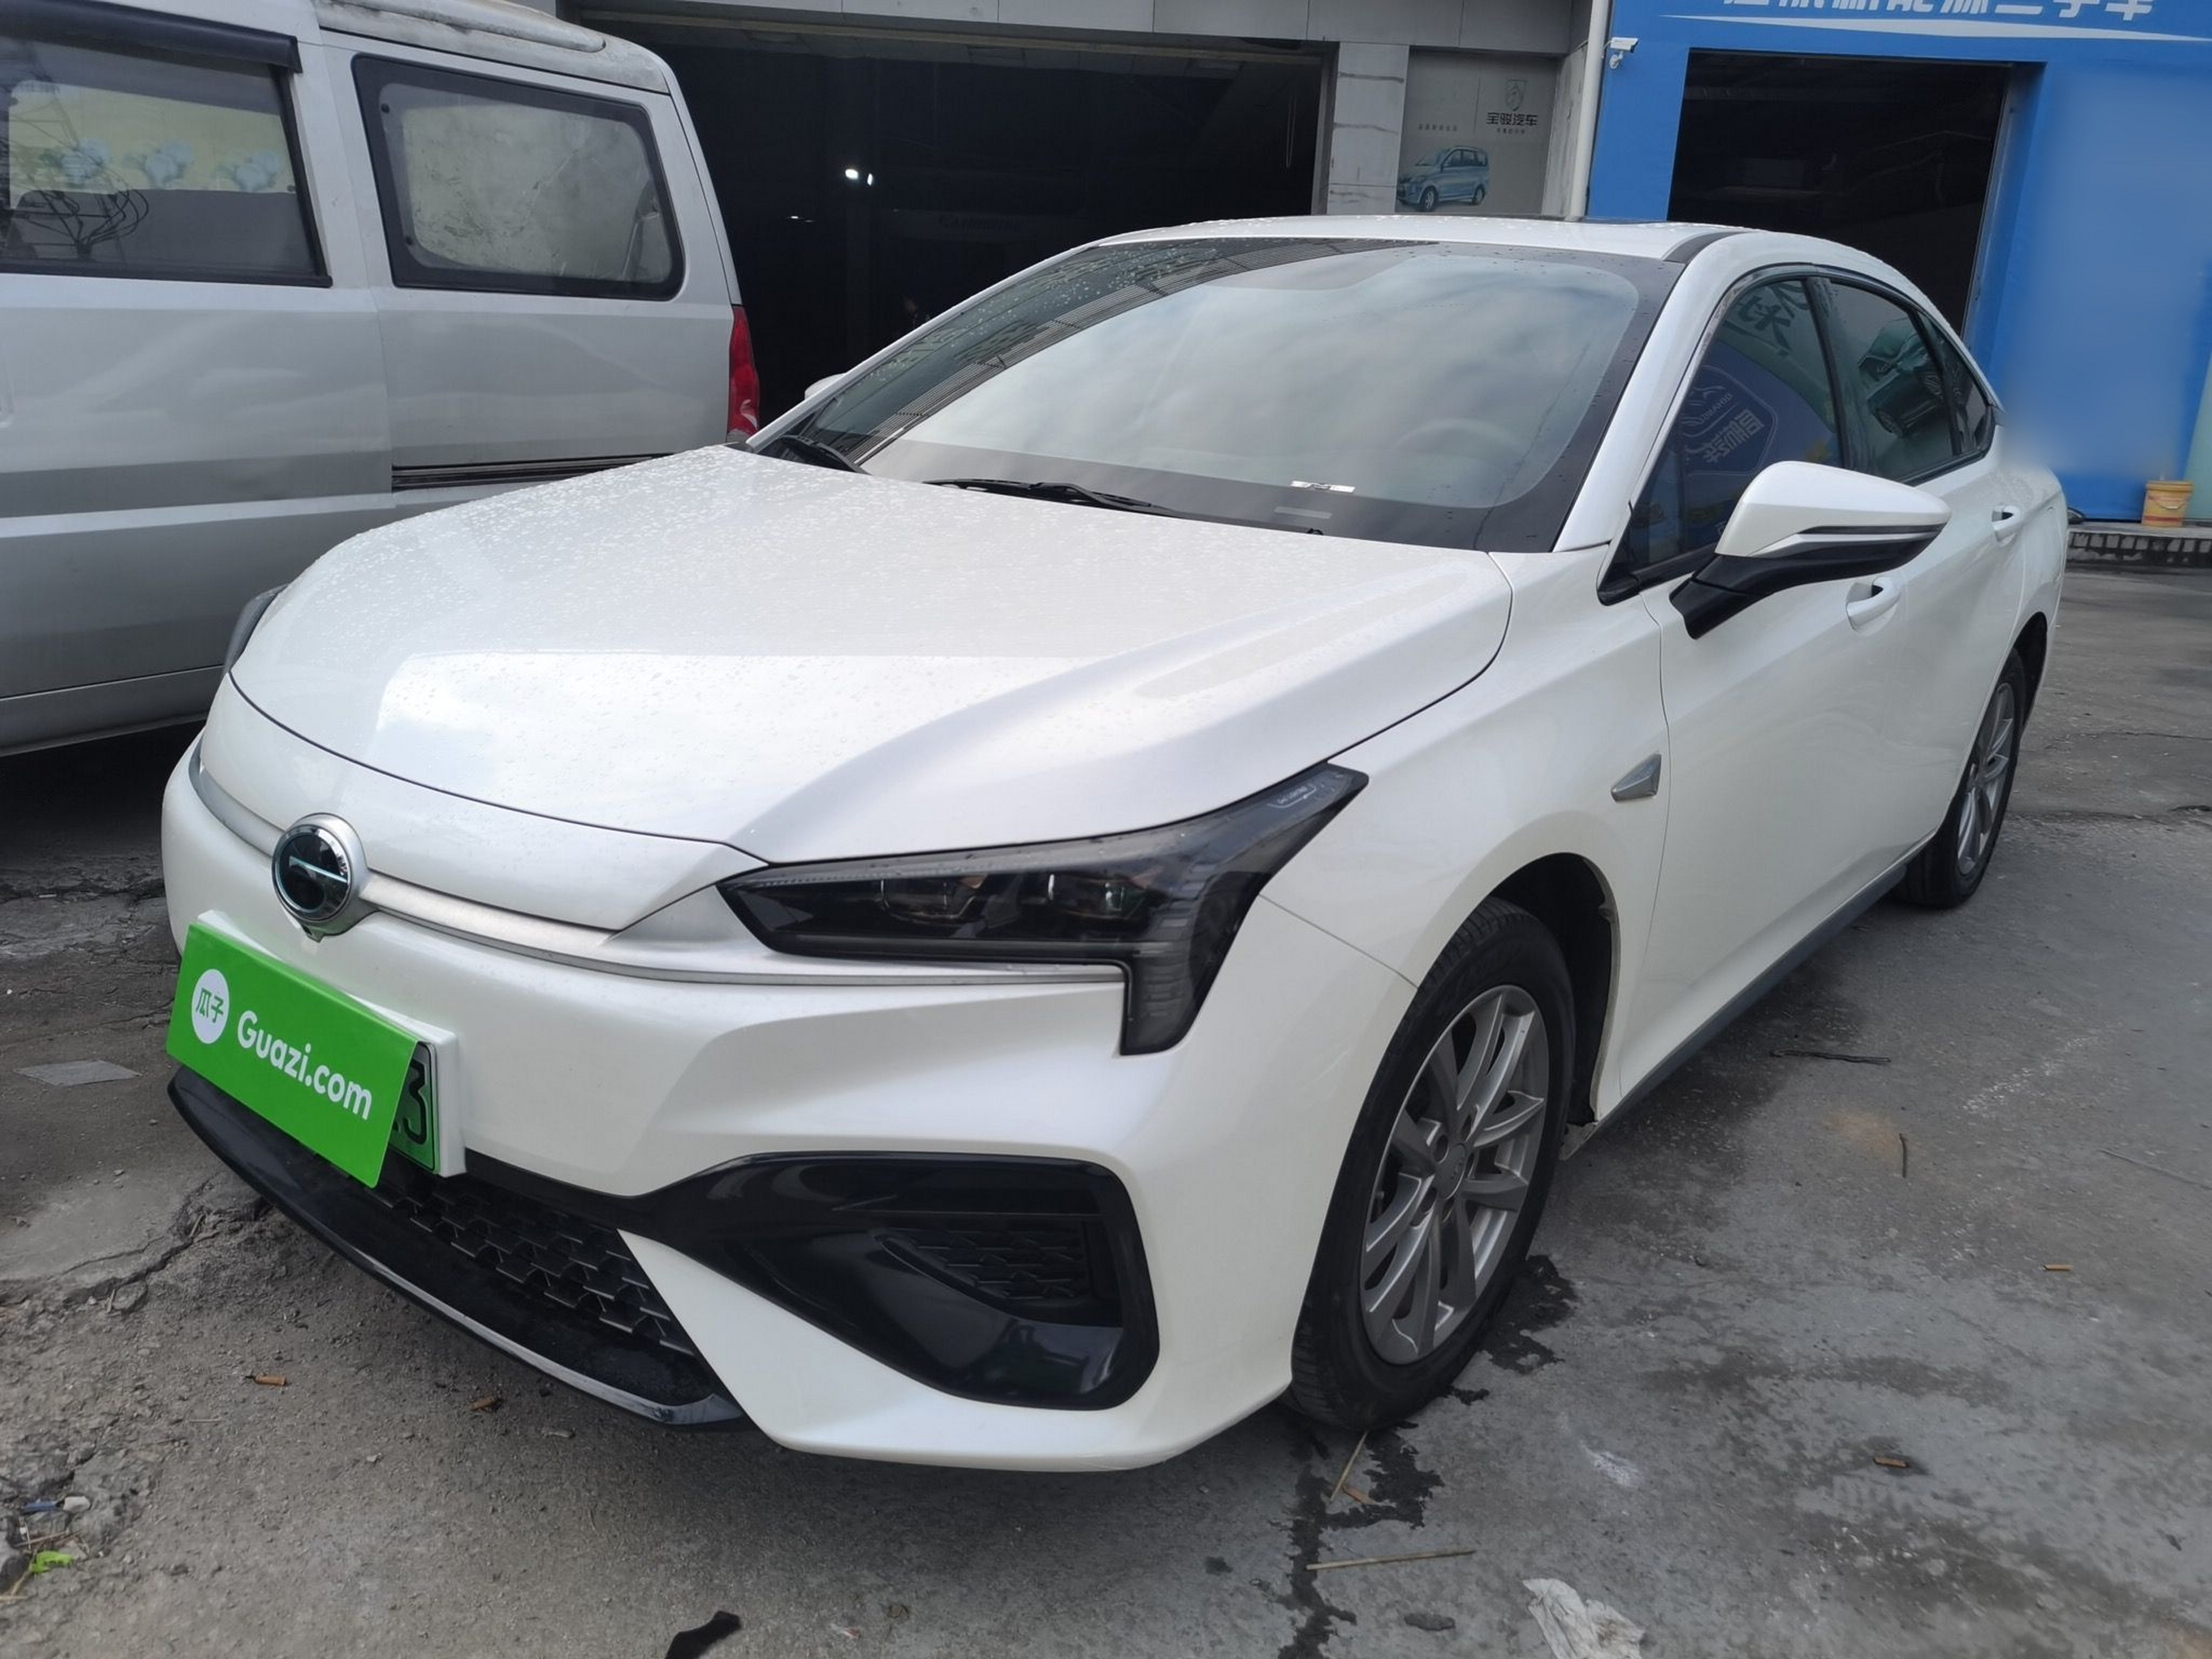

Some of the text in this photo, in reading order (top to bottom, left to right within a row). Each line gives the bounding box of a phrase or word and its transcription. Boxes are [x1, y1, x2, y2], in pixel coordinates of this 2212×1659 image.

[1486, 112, 1538, 126] 宝骏汽车
[195, 987, 224, 1023] 瓜子
[237, 1010, 373, 1120] Guazi.com
